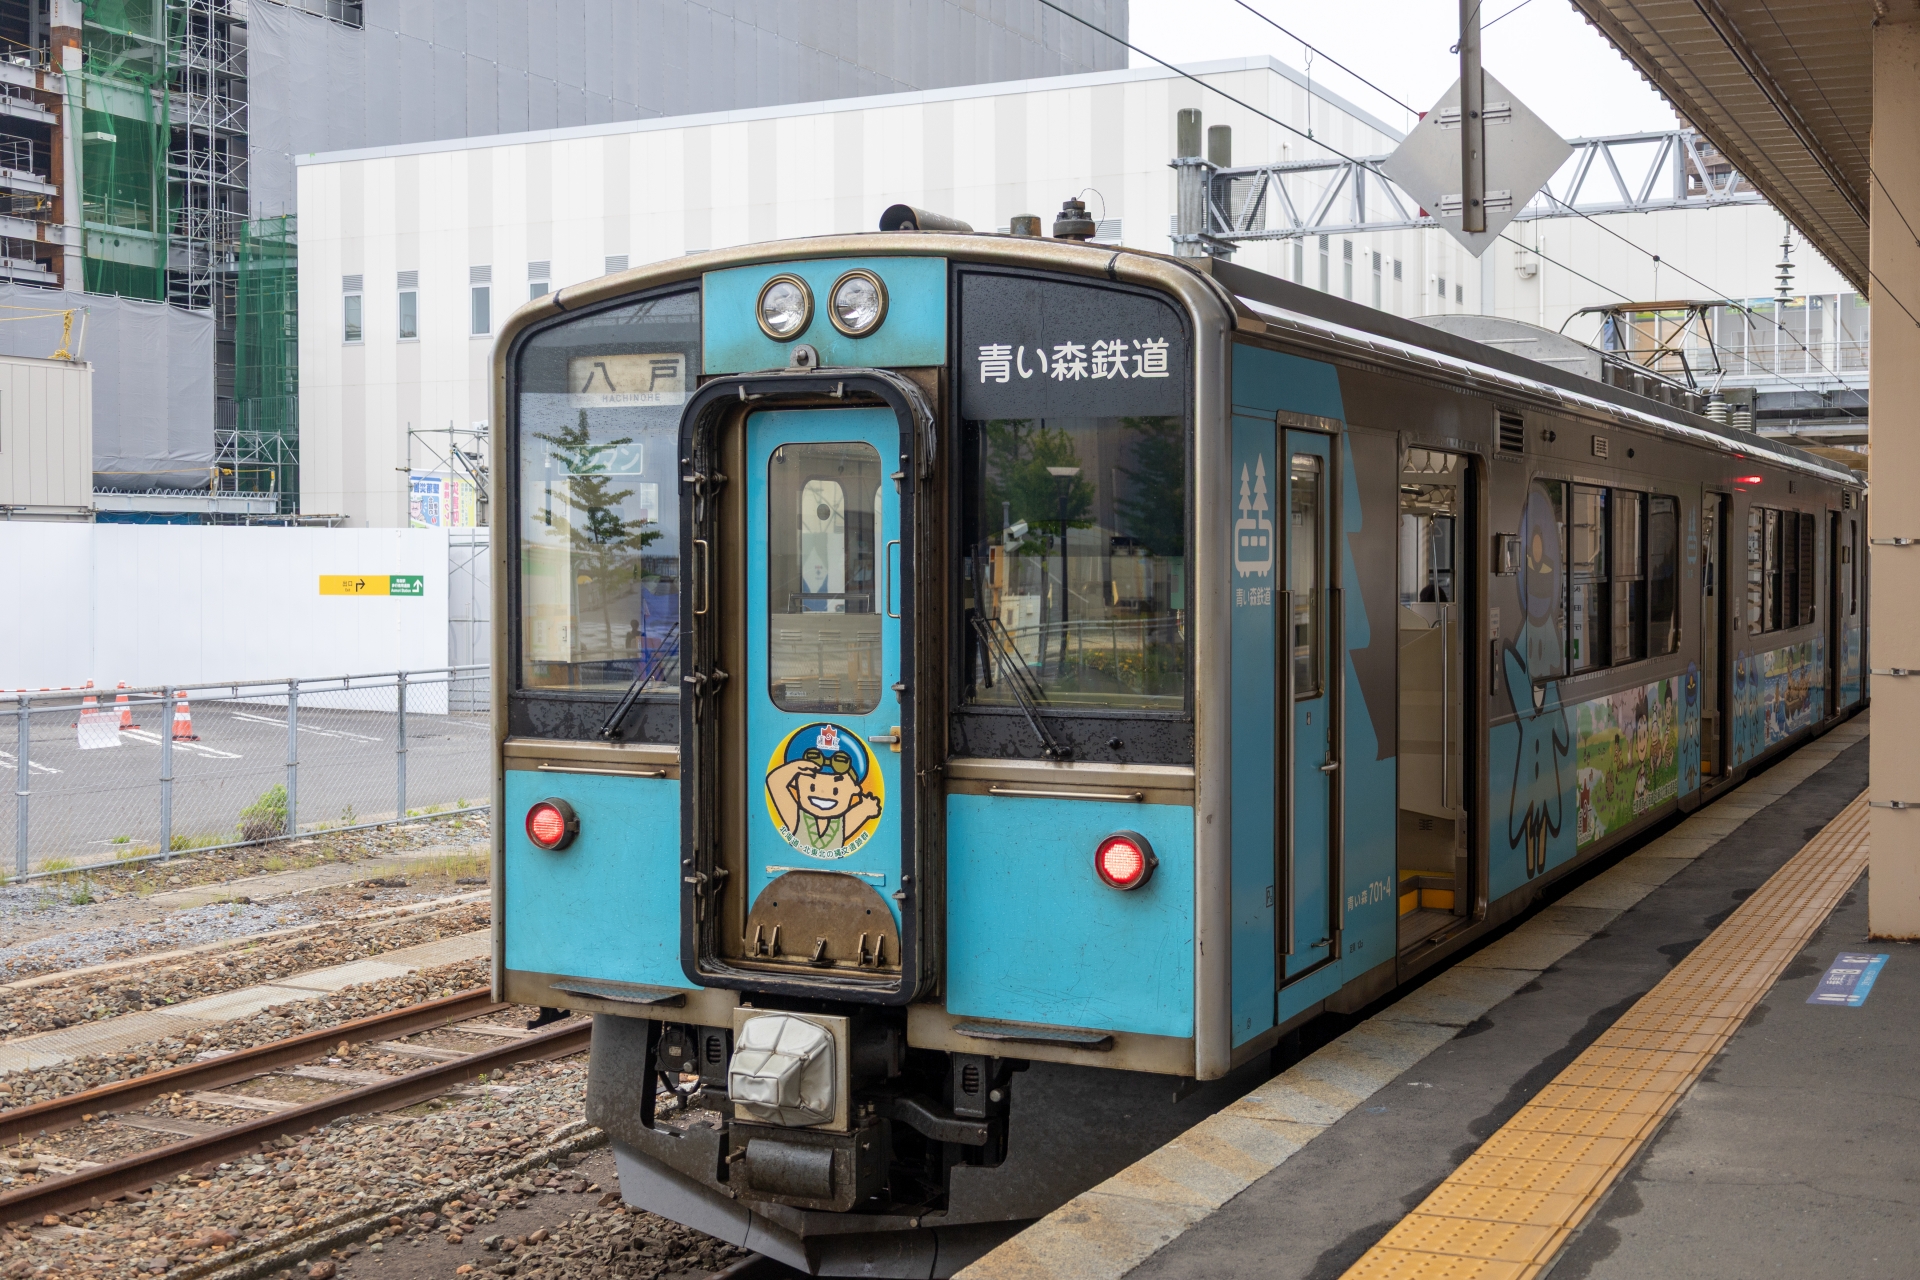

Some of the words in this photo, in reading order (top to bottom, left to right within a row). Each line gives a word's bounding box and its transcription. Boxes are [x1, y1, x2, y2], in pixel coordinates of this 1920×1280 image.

[977, 336, 1171, 384] 青い森鉄道
[581, 358, 679, 394] 八戸
[601, 393, 661, 403] HACHINOHE
[1235, 586, 1271, 607] 青い森鉄道
[1347, 889, 1368, 912] 青い森
